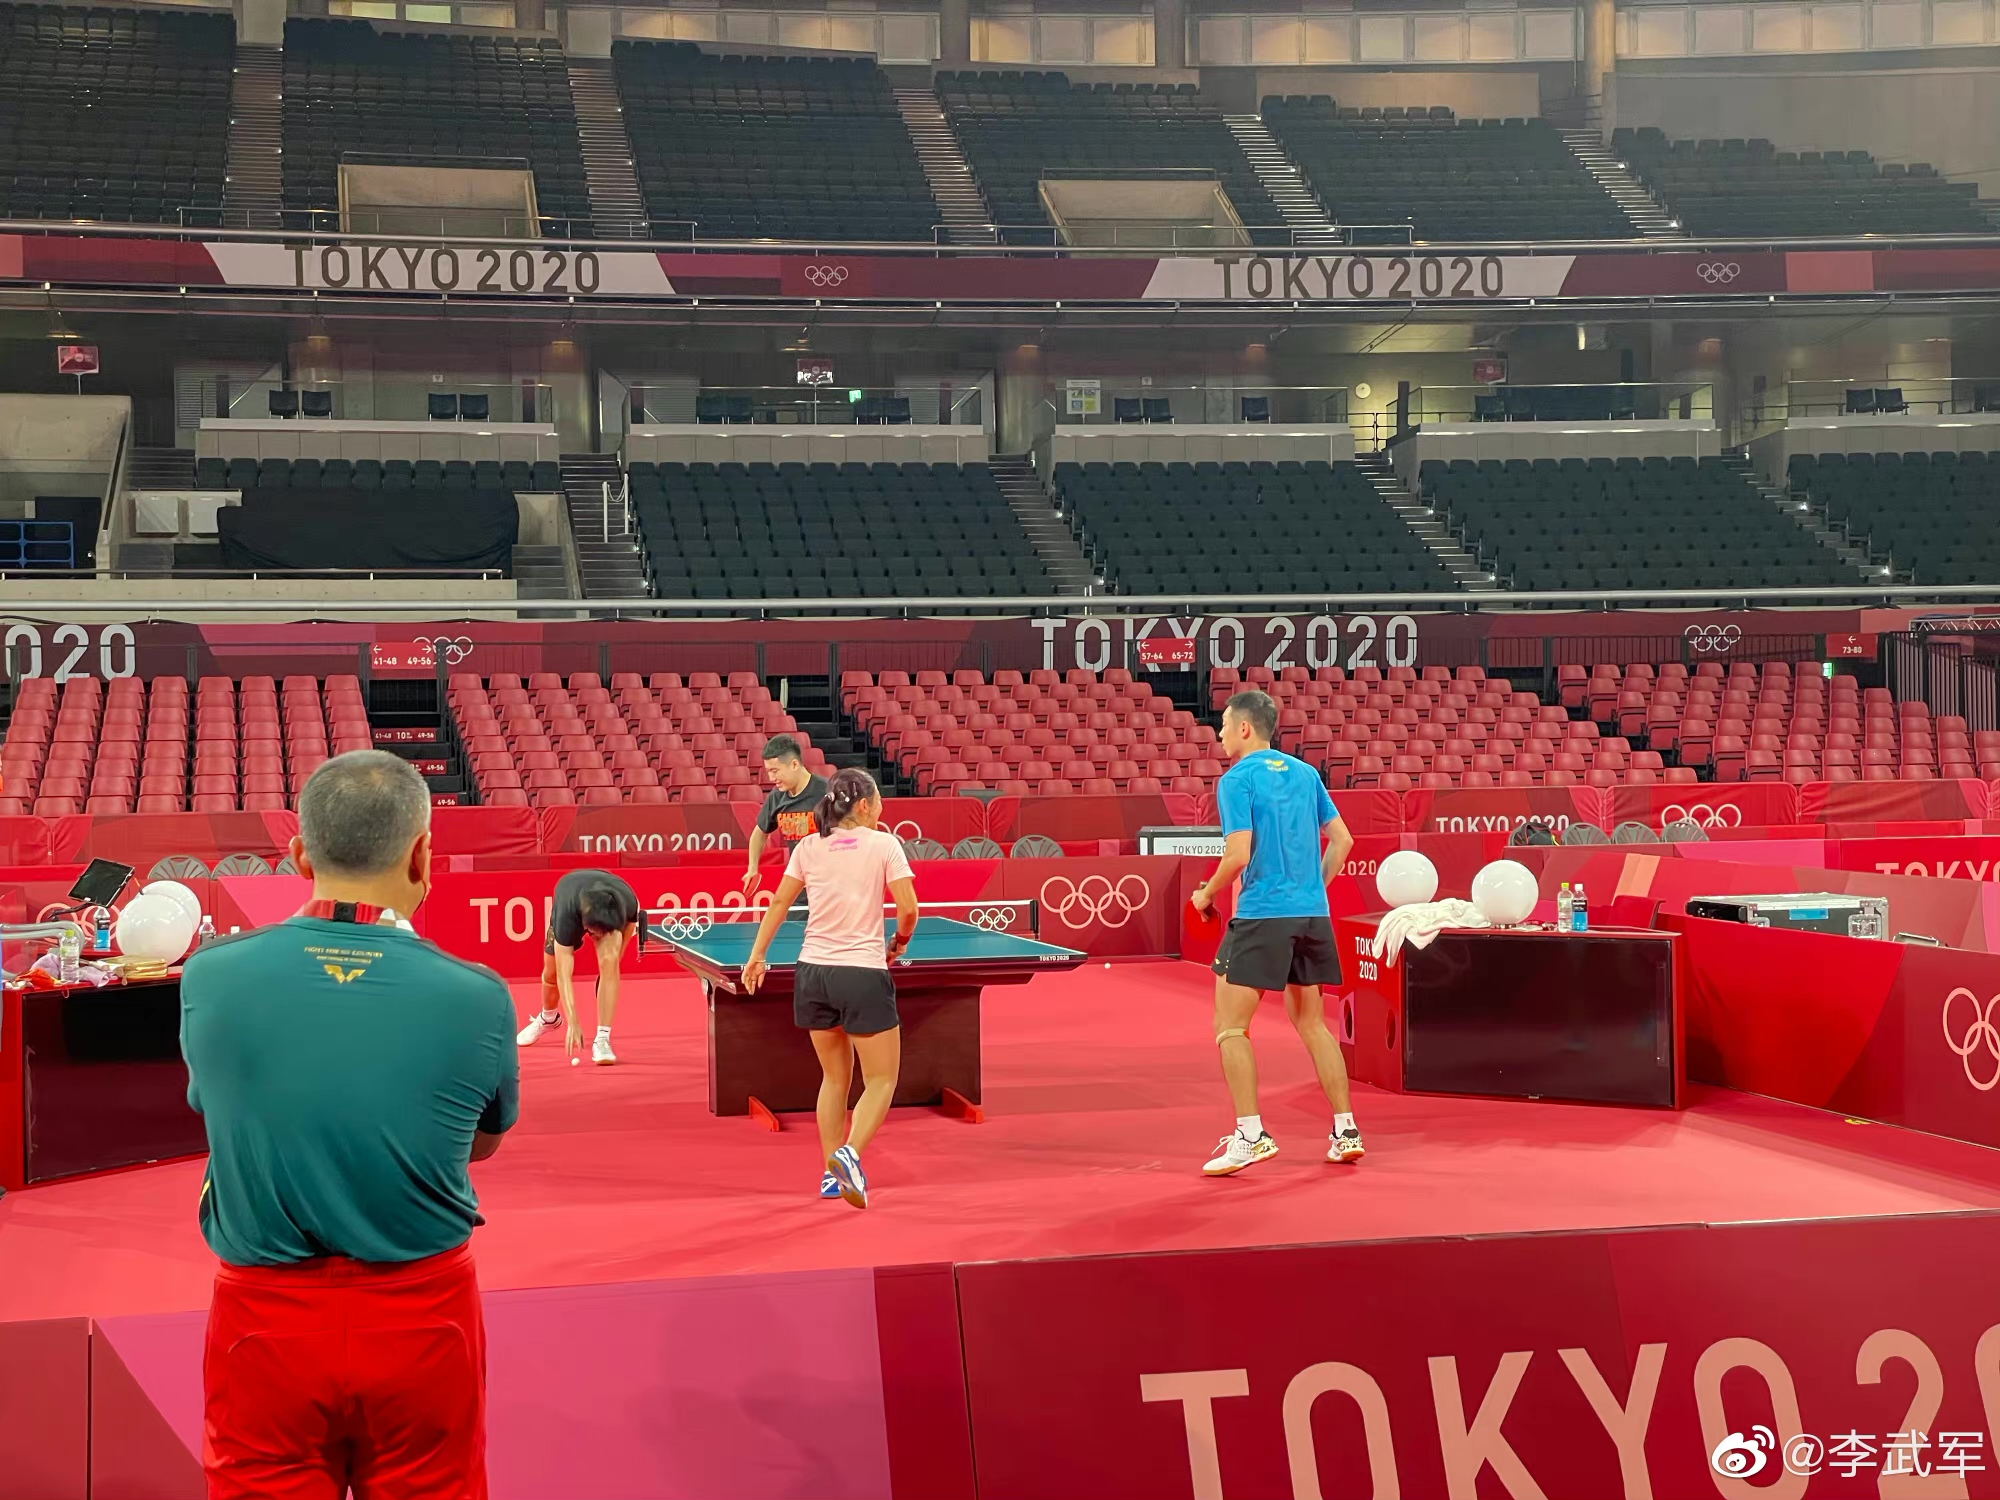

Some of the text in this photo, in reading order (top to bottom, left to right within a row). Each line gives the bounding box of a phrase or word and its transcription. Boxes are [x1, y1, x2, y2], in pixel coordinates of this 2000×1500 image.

[284, 243, 600, 293] TOKYO 2020
[1213, 256, 1504, 299] TOKYO 2020
[1031, 615, 1418, 673] TOKYO 2020
[373, 656, 432, 666] 41-48 49-56
[1141, 651, 1194, 660] 57-64 65-72
[1435, 816, 1510, 833] TOKYO
[579, 834, 664, 853] TOKYO
[1172, 845, 1203, 855] TOKYO
[1359, 960, 1378, 981] 2020
[1140, 1336, 1807, 1500] TOKYO
